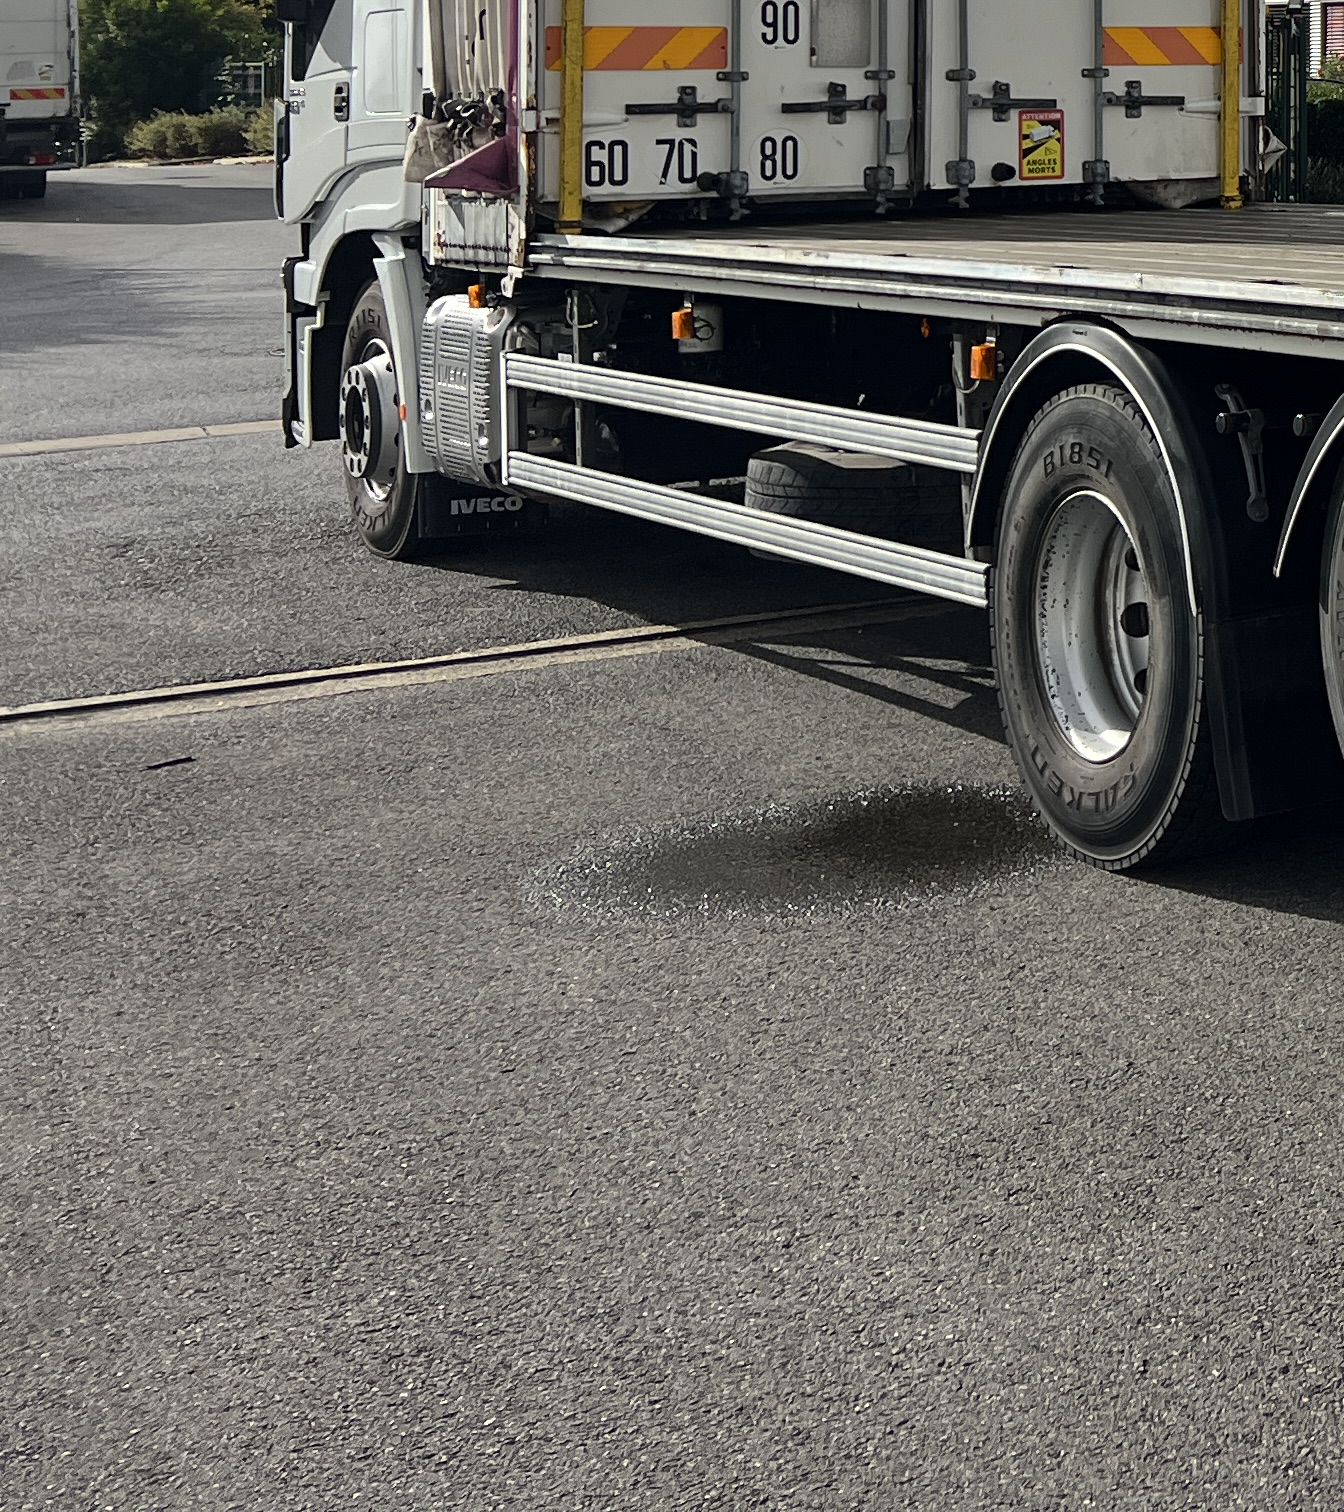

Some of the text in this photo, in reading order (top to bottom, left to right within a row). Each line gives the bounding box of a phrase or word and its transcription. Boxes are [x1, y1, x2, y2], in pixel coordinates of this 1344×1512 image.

[762, 0, 799, 45] 90
[585, 136, 798, 186] 60 70 80
[1026, 158, 1057, 166] ANGLES
[450, 497, 524, 516] IVECO
